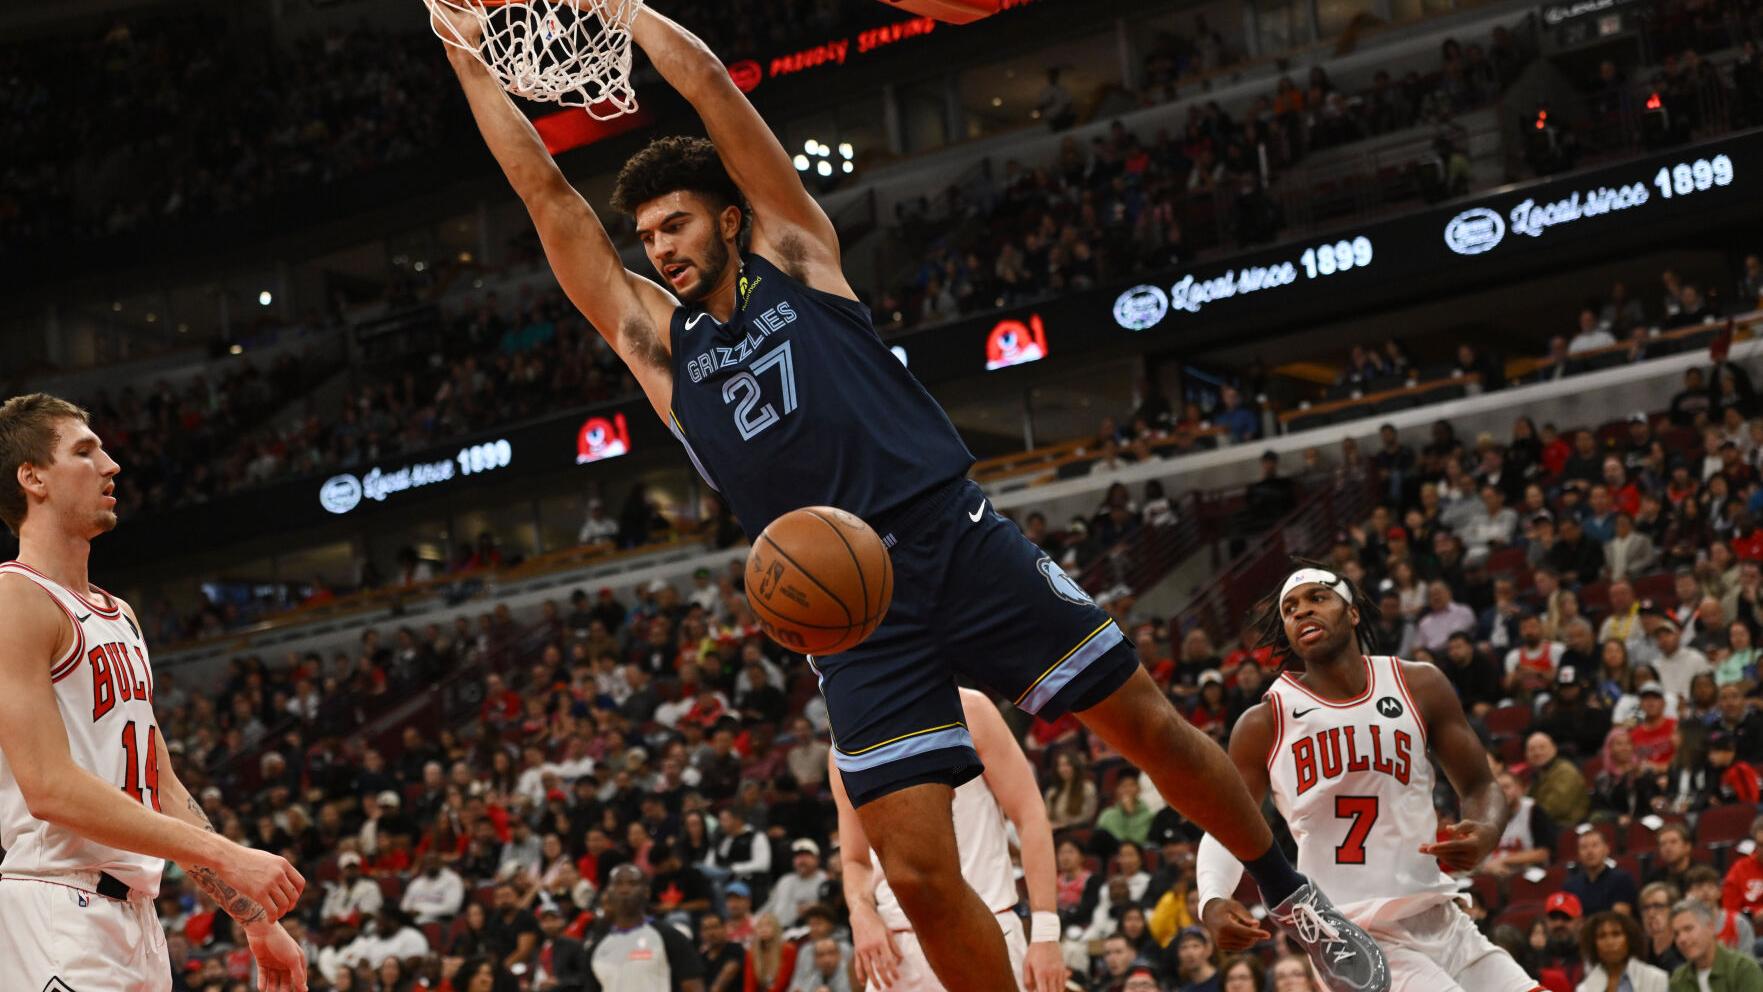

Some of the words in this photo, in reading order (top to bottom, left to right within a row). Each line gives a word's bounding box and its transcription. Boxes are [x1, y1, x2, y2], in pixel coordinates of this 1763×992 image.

[1654, 154, 1734, 199] 1899
[1301, 235, 1373, 279] 1899
[687, 301, 798, 383] GRIZZLIES
[721, 340, 798, 442] 27
[1291, 724, 1412, 797] BULLS
[1334, 795, 1379, 865] 7
